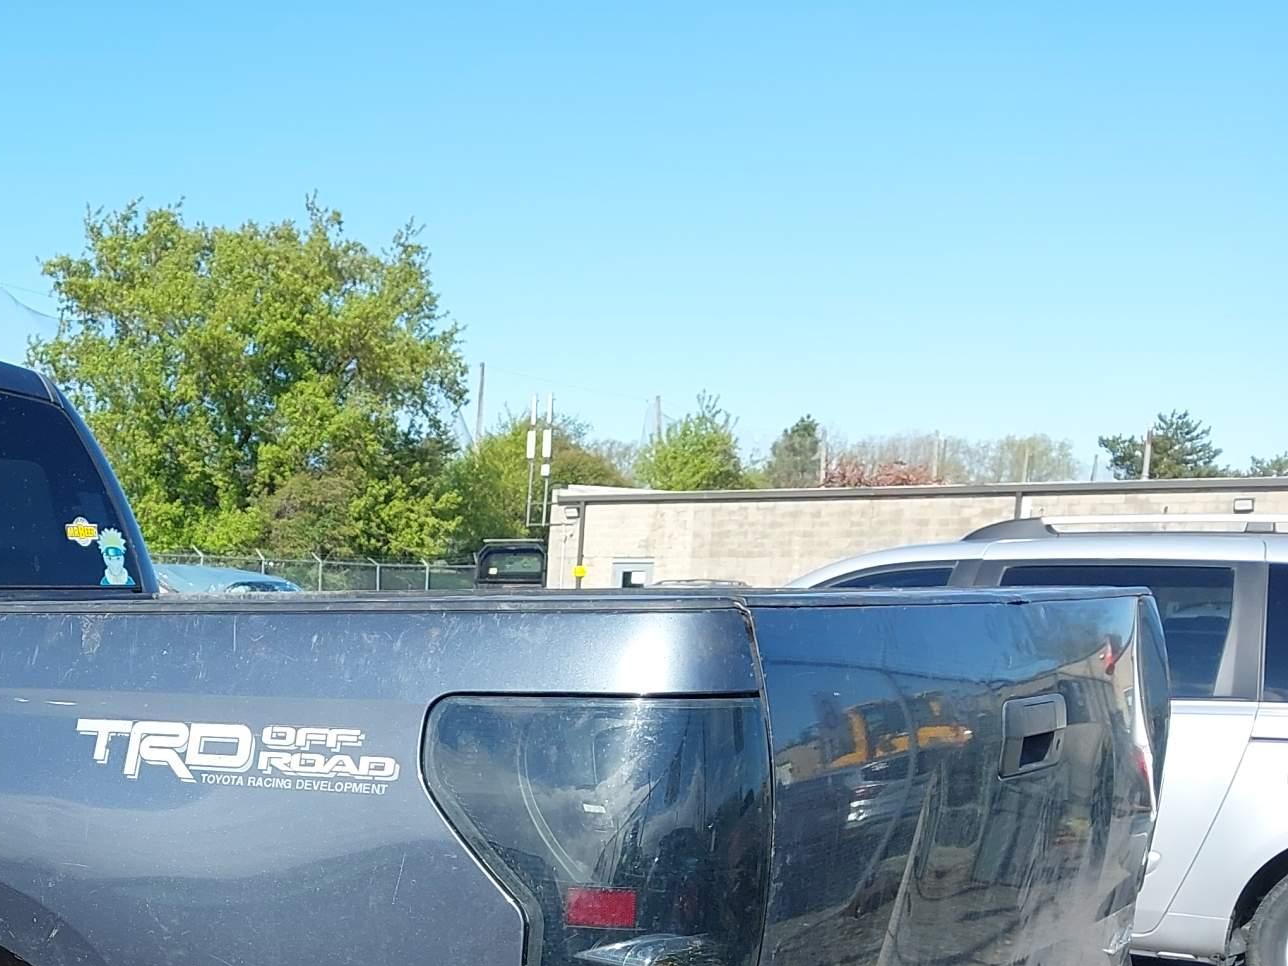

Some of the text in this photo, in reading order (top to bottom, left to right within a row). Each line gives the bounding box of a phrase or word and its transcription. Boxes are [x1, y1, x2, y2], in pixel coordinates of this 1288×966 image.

[76, 718, 255, 783] TRD
[262, 725, 365, 752] OFF
[257, 751, 401, 782] ROAD
[200, 772, 389, 795] TOYOTA RACING DEVELOPMENT
